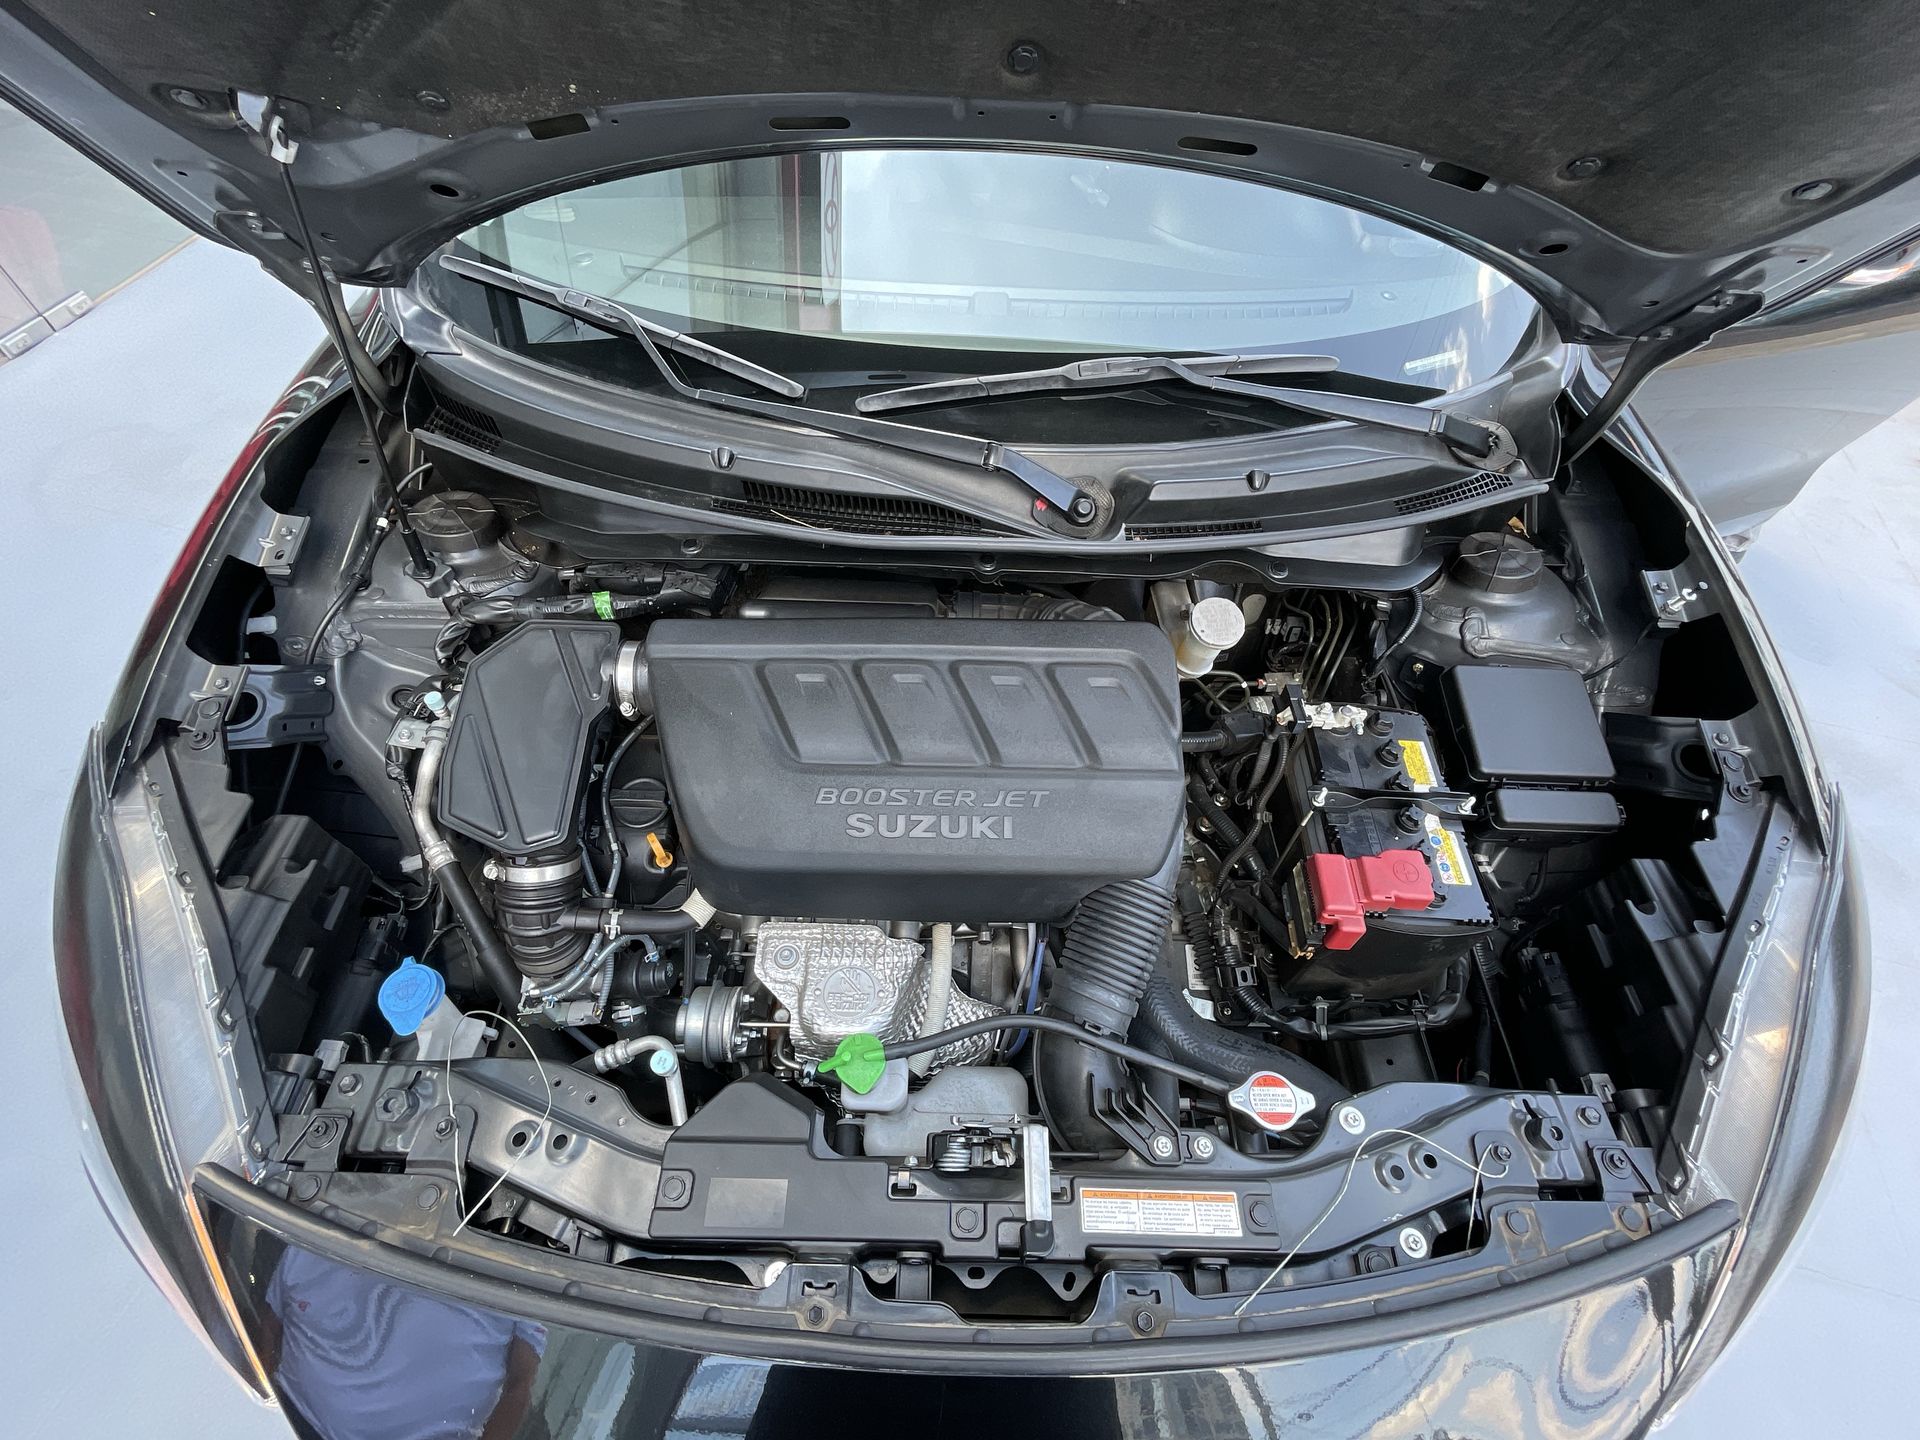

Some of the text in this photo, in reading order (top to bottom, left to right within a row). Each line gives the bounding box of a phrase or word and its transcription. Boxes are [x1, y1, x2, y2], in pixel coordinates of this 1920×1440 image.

[815, 787, 1050, 807] BOOSTER JET
[846, 813, 1013, 839] SUZUKI
